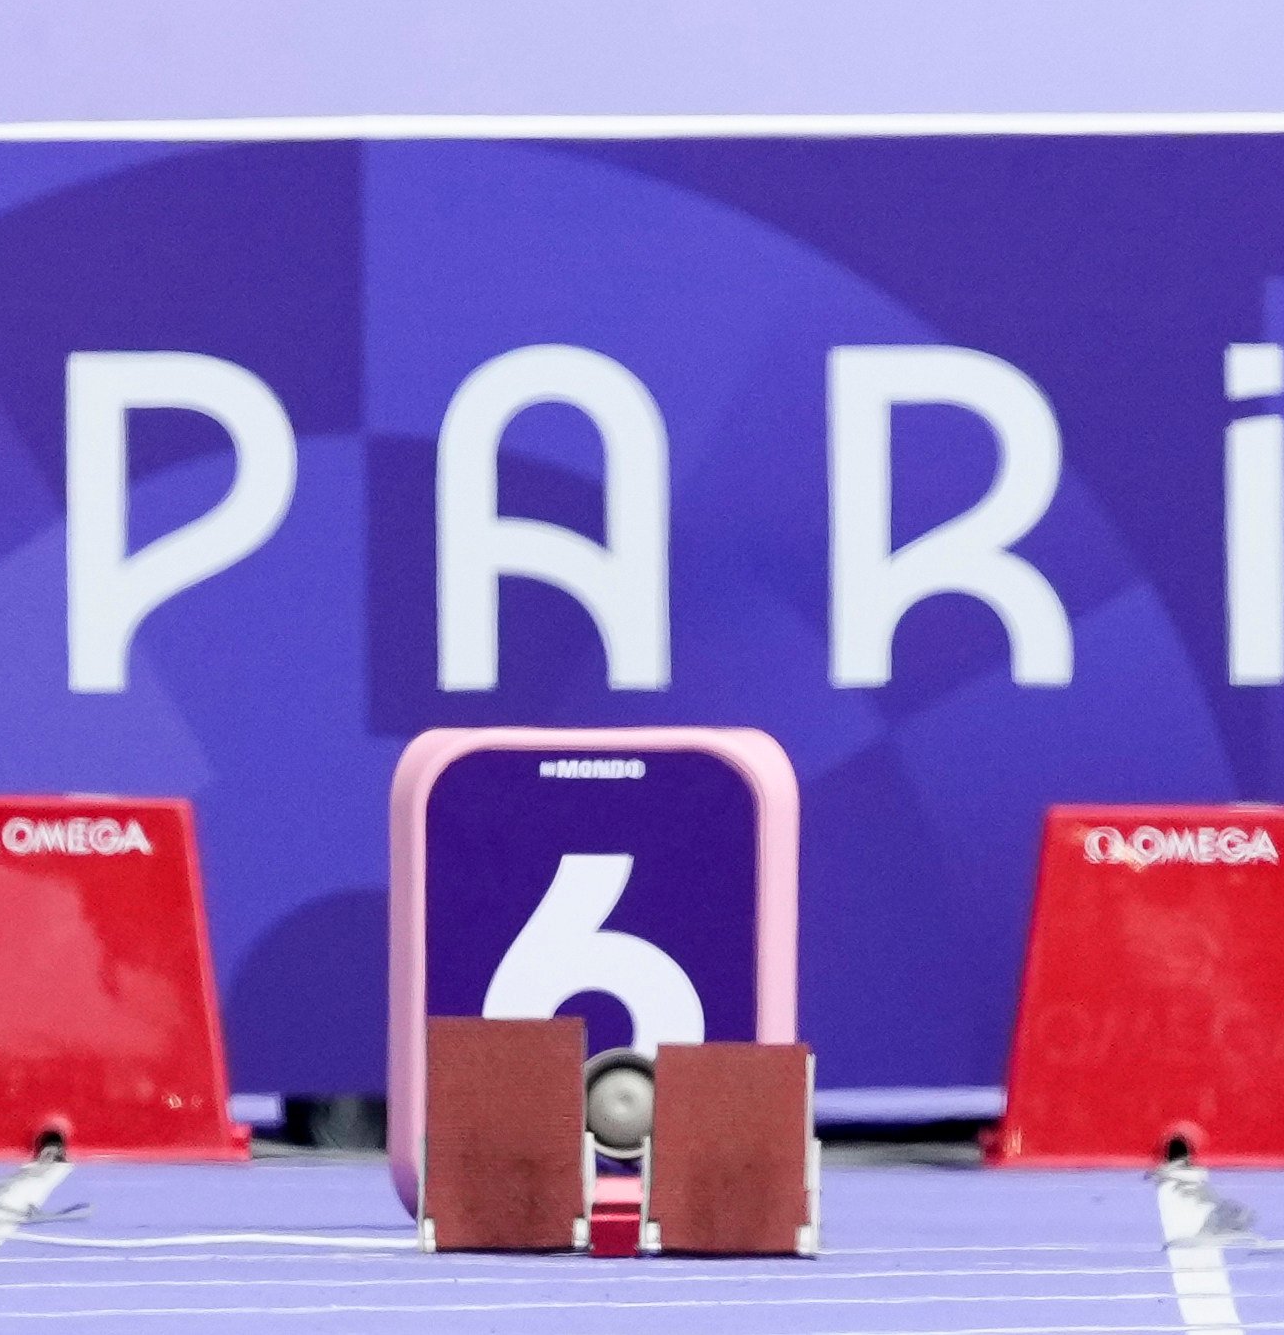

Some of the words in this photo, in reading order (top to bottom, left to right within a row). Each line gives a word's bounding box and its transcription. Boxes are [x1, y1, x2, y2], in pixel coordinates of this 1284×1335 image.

[2, 817, 153, 855] OMEGA
[1130, 826, 1279, 864] OMEGA
[484, 853, 705, 1056] 6
